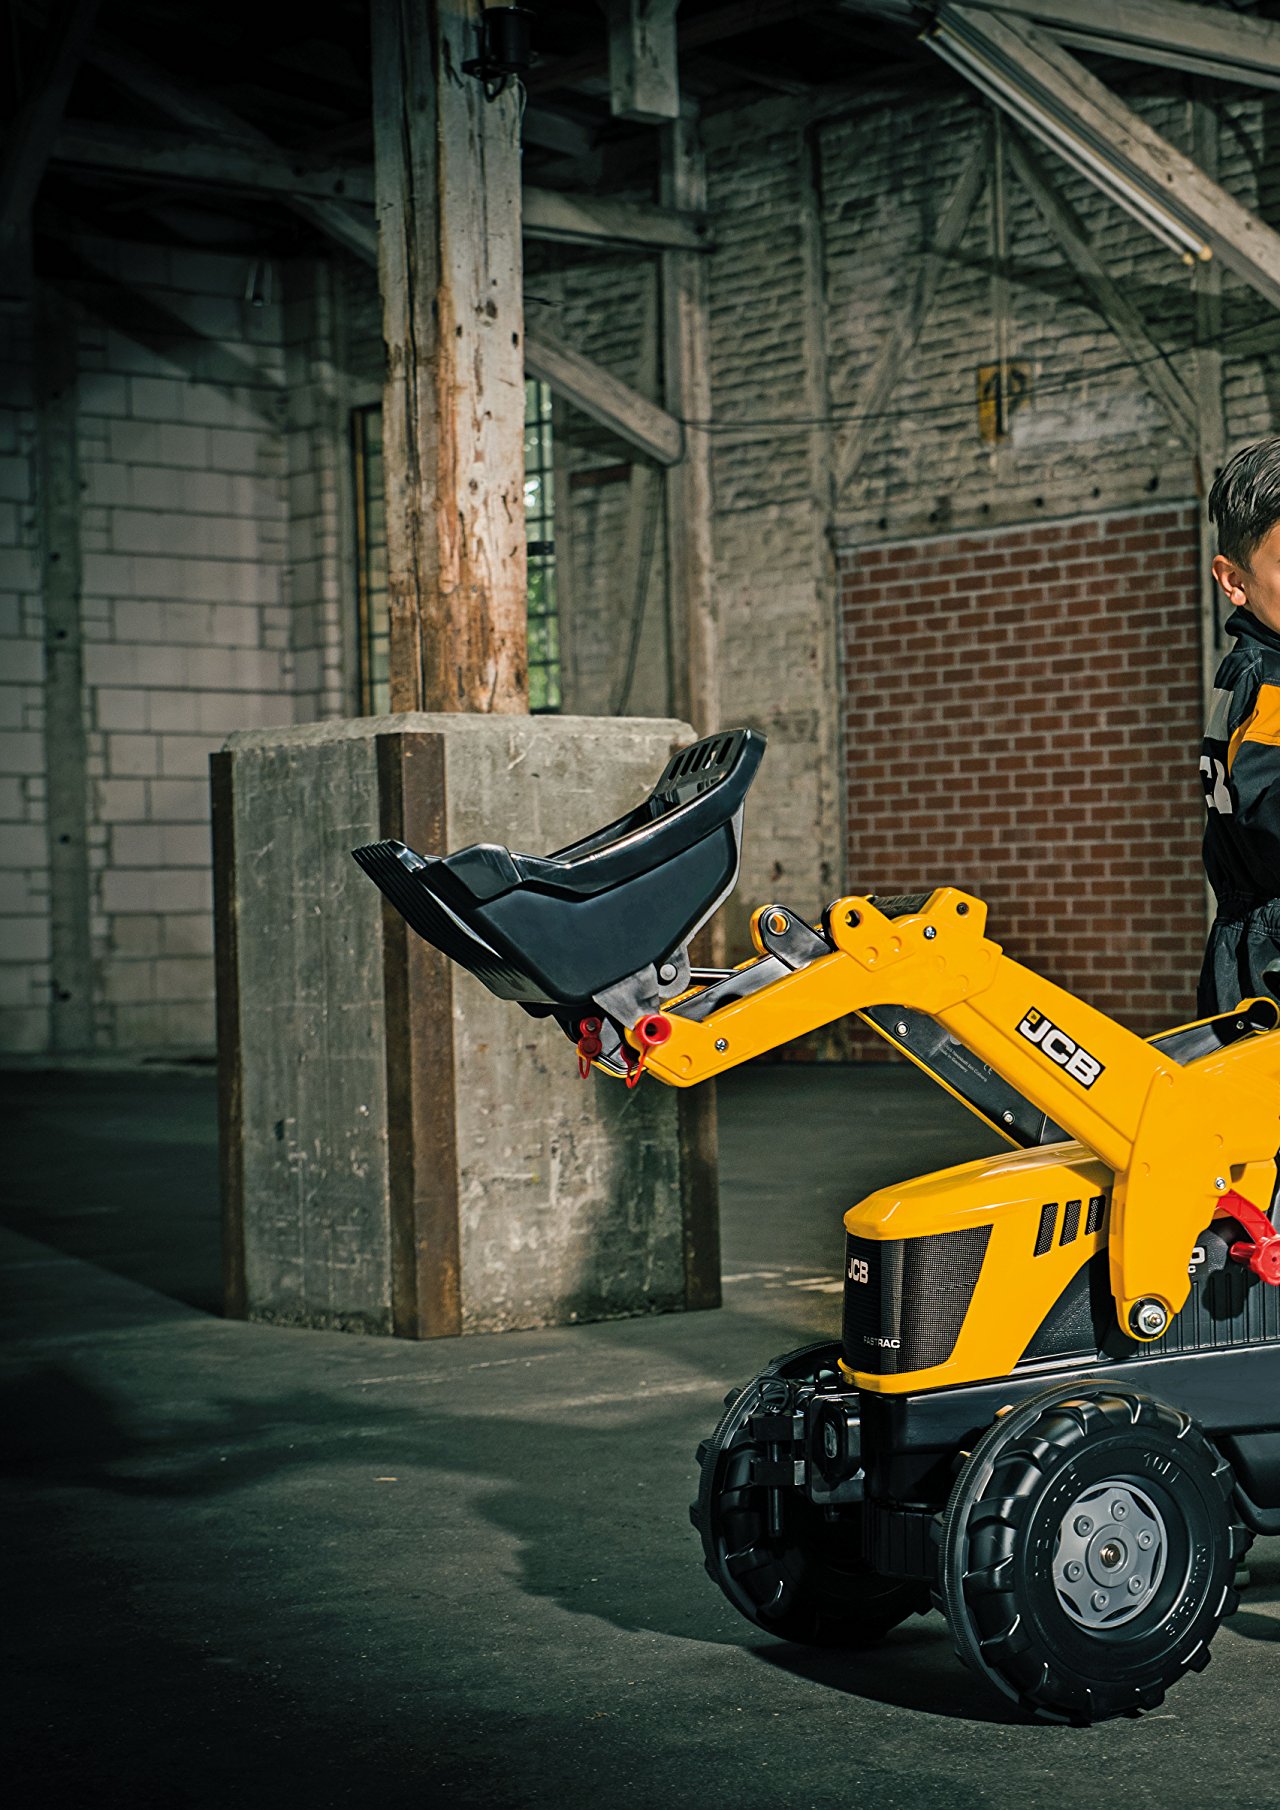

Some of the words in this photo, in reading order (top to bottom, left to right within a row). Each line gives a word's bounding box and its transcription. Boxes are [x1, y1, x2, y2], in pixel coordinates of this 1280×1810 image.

[1019, 1019, 1101, 1086] JCB
[848, 1257, 869, 1284] JCB
[863, 1335, 901, 1349] FASTRAC
